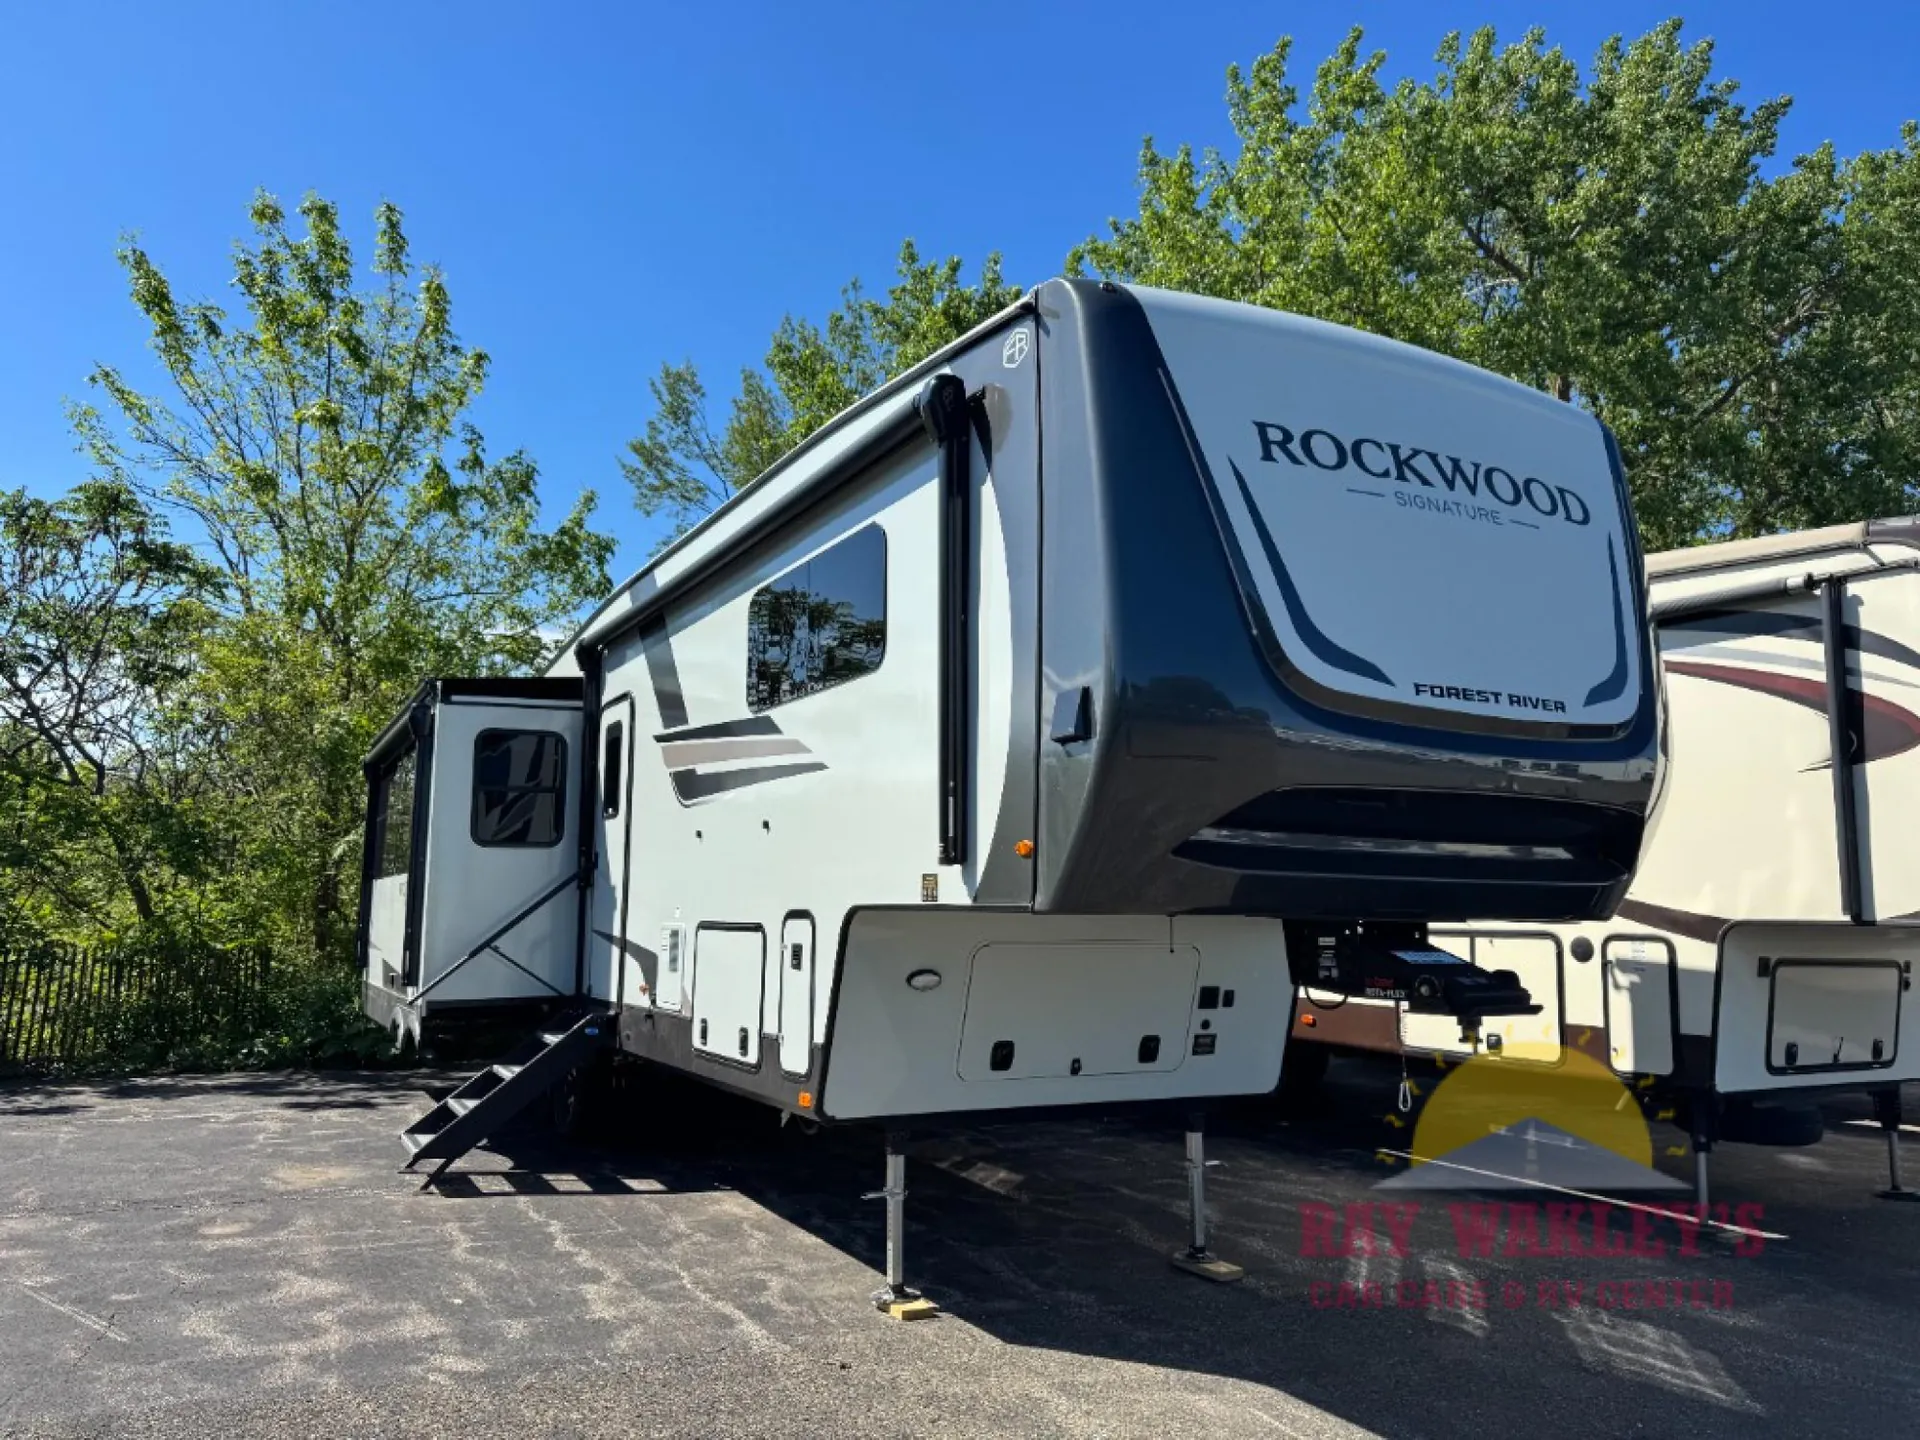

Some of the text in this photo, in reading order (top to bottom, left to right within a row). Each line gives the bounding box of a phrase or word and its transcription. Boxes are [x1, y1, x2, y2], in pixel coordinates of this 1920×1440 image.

[1252, 420, 1591, 526] ROCKWOOD
[1395, 490, 1503, 526] SIGNATURE
[1413, 682, 1567, 714] FOREST RIVER
